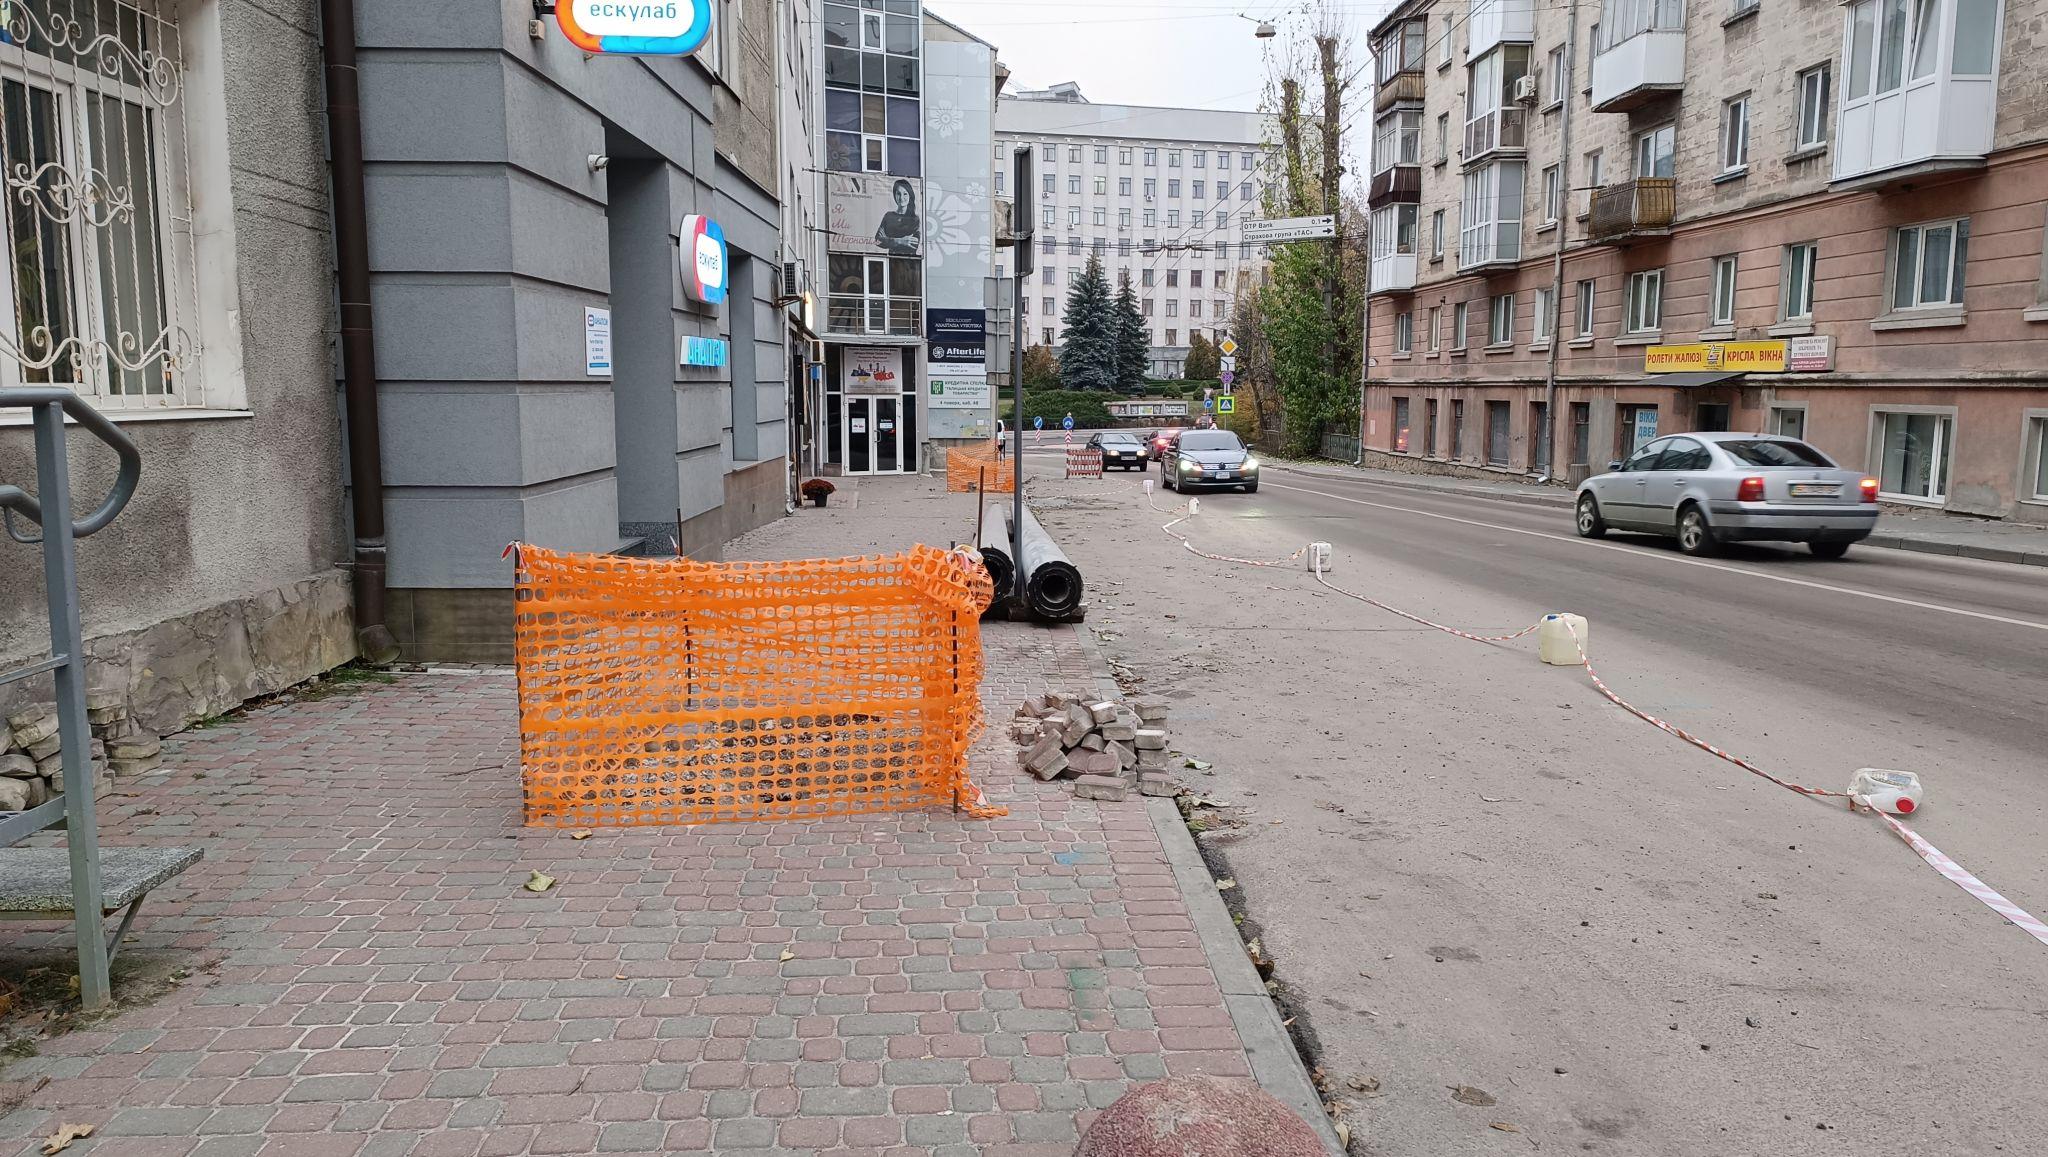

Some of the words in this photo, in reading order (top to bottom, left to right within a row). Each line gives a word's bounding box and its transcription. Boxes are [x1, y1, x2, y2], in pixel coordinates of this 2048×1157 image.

[590, 3, 677, 21] ескулаб
[946, 347, 985, 356] AfterLife
[1647, 353, 1673, 364] РОЛЕТИ
[1674, 352, 1702, 362] ЖАЛЮЗІ
[1727, 350, 1756, 362] КРІСЛА
[1759, 349, 1784, 361] ВІКНА
